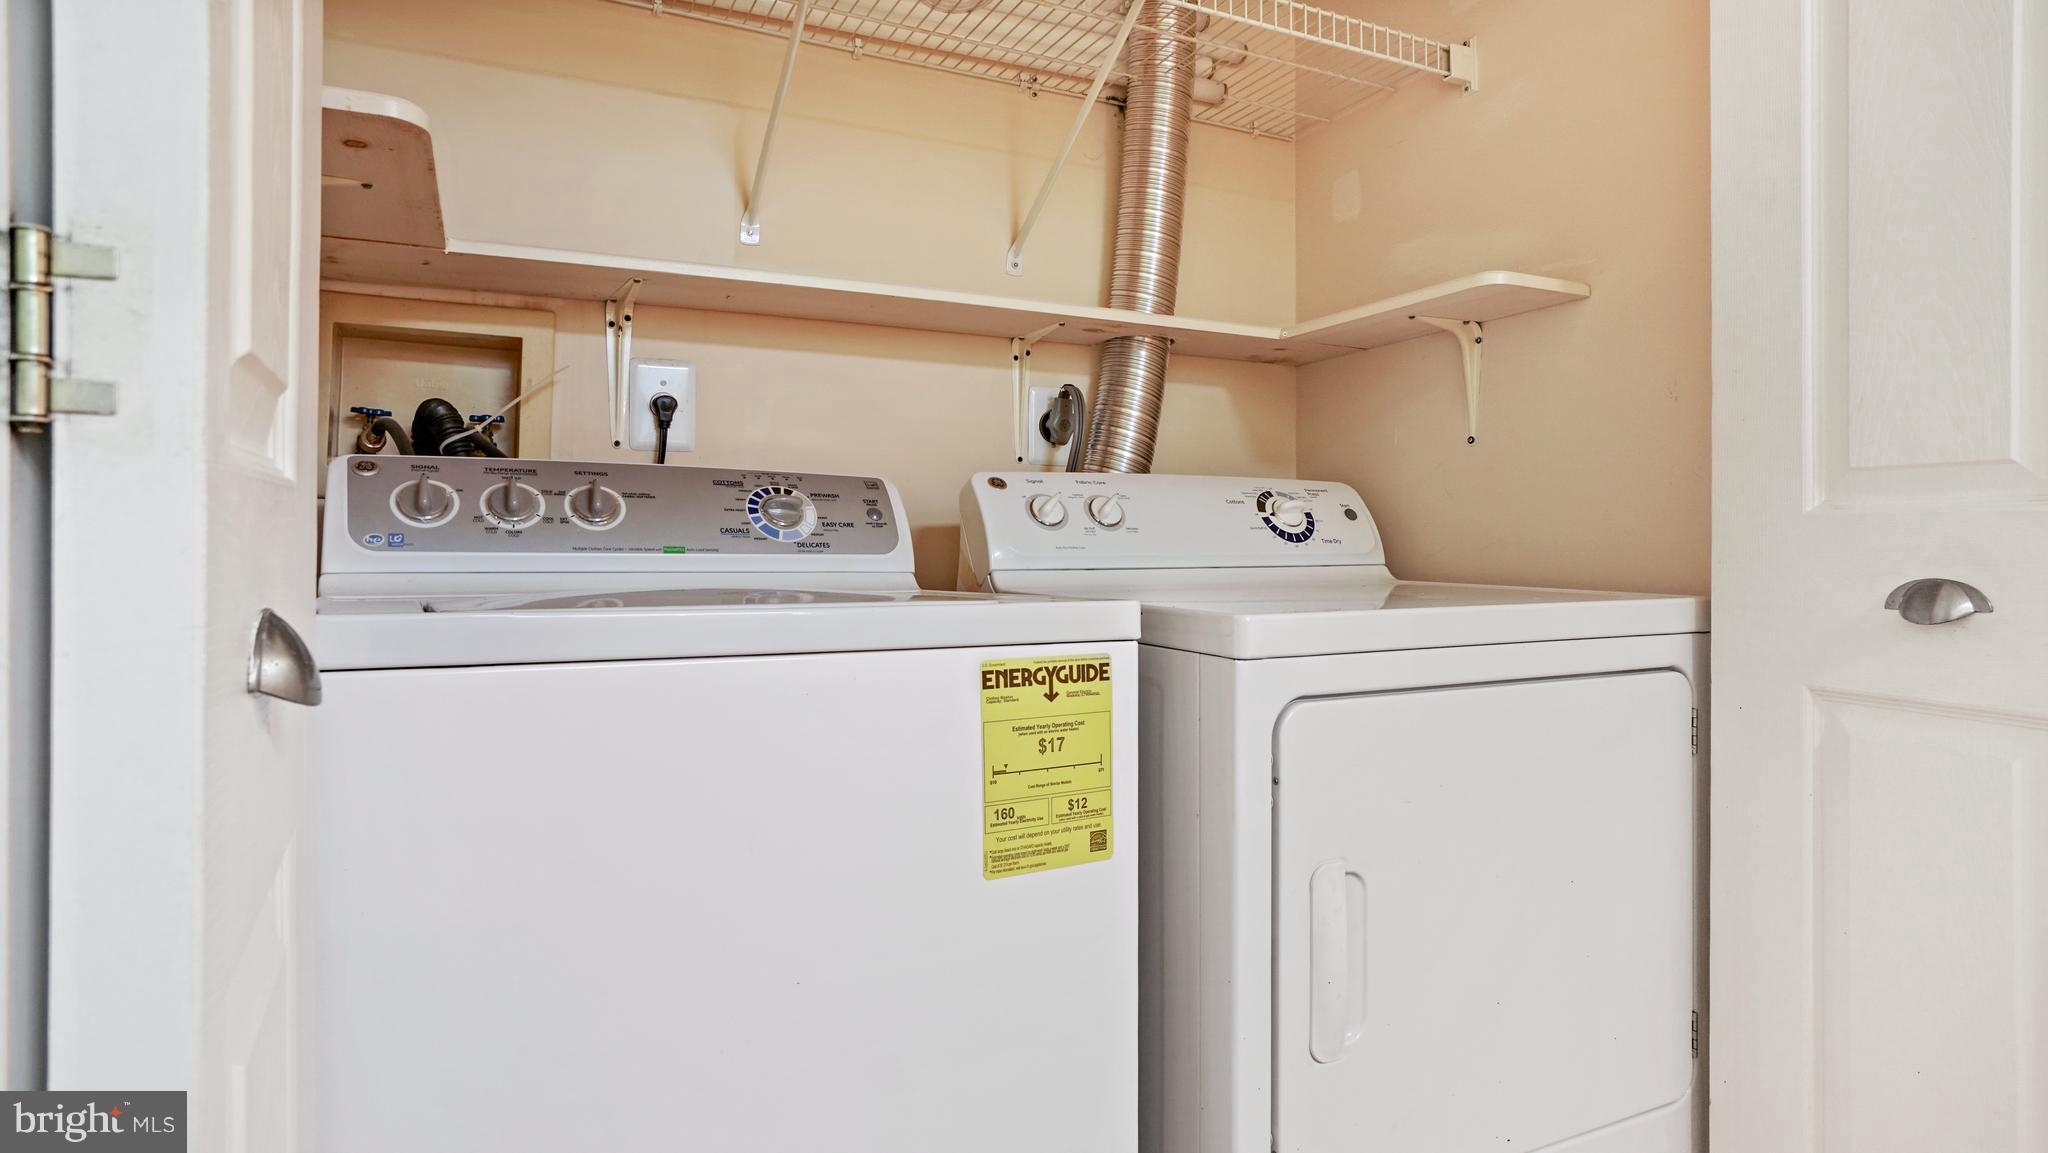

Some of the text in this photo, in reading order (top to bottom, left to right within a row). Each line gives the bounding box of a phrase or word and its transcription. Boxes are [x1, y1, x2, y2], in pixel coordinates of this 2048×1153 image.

[797, 541, 831, 549] DELICATES
[981, 662, 1111, 690] ENERGYGUIDE
[1036, 723, 1051, 731] Yearly
[1052, 721, 1074, 730] Operating
[1038, 737, 1066, 756] $17
[1067, 797, 1088, 812] $12
[994, 807, 1016, 821] 160
[1026, 831, 1043, 840] depend
[1060, 826, 1072, 834] utility
[1073, 824, 1084, 832] rates
